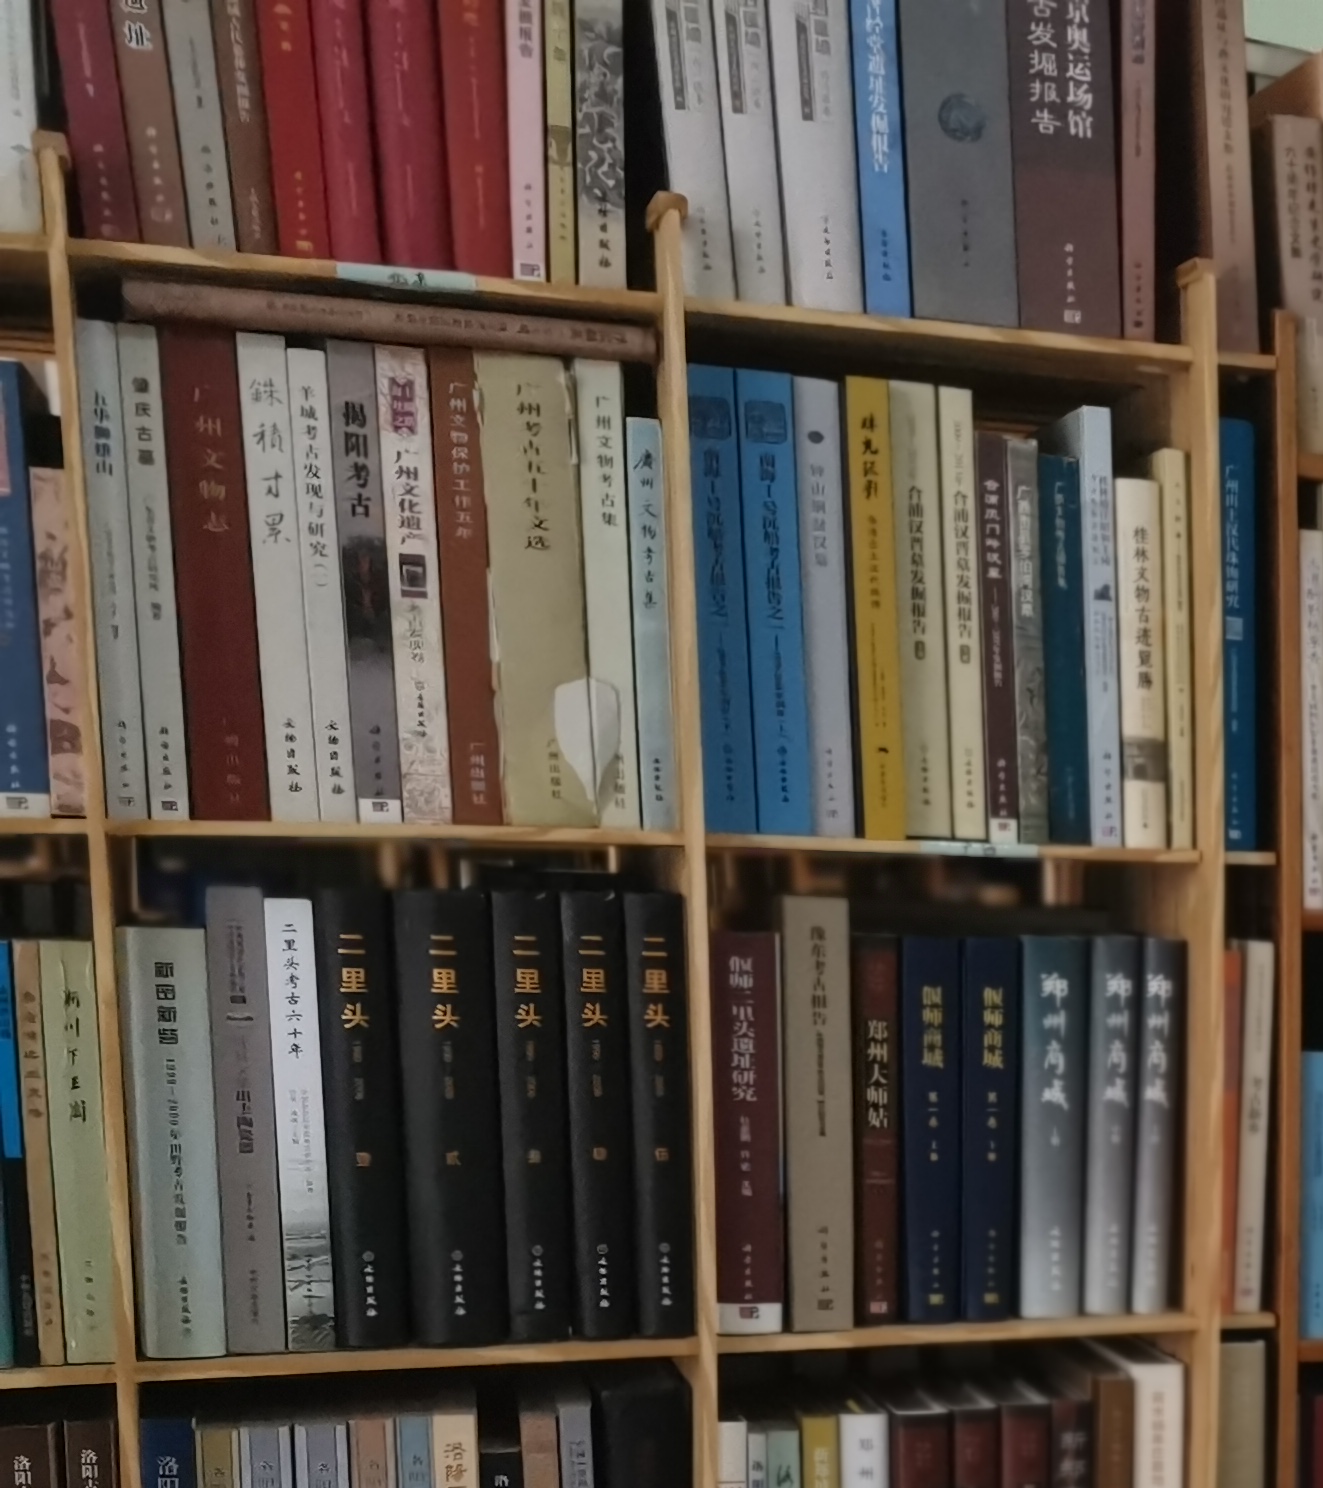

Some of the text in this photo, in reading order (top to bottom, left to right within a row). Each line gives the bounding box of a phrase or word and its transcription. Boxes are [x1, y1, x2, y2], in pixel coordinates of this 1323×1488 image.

[342, 400, 373, 519] 揭阳考古
[393, 447, 422, 545] 广州文化遗产
[448, 381, 474, 540] 广州文物保护工作五年
[595, 395, 618, 527] 广州文物考古集
[281, 922, 304, 1060] 二里头考古六十年
[337, 933, 371, 1030] 二里头
[428, 934, 461, 1030] 二里头
[513, 935, 543, 1029] 二里头
[579, 934, 608, 1029] 二里头
[641, 936, 671, 1029] 二里头
[729, 955, 757, 1102] 偃师二里头遗址研究
[921, 985, 945, 1070] 偃师商城
[983, 986, 1005, 1070] 偃师商城
[866, 1020, 888, 1129] 郑州大师姑
